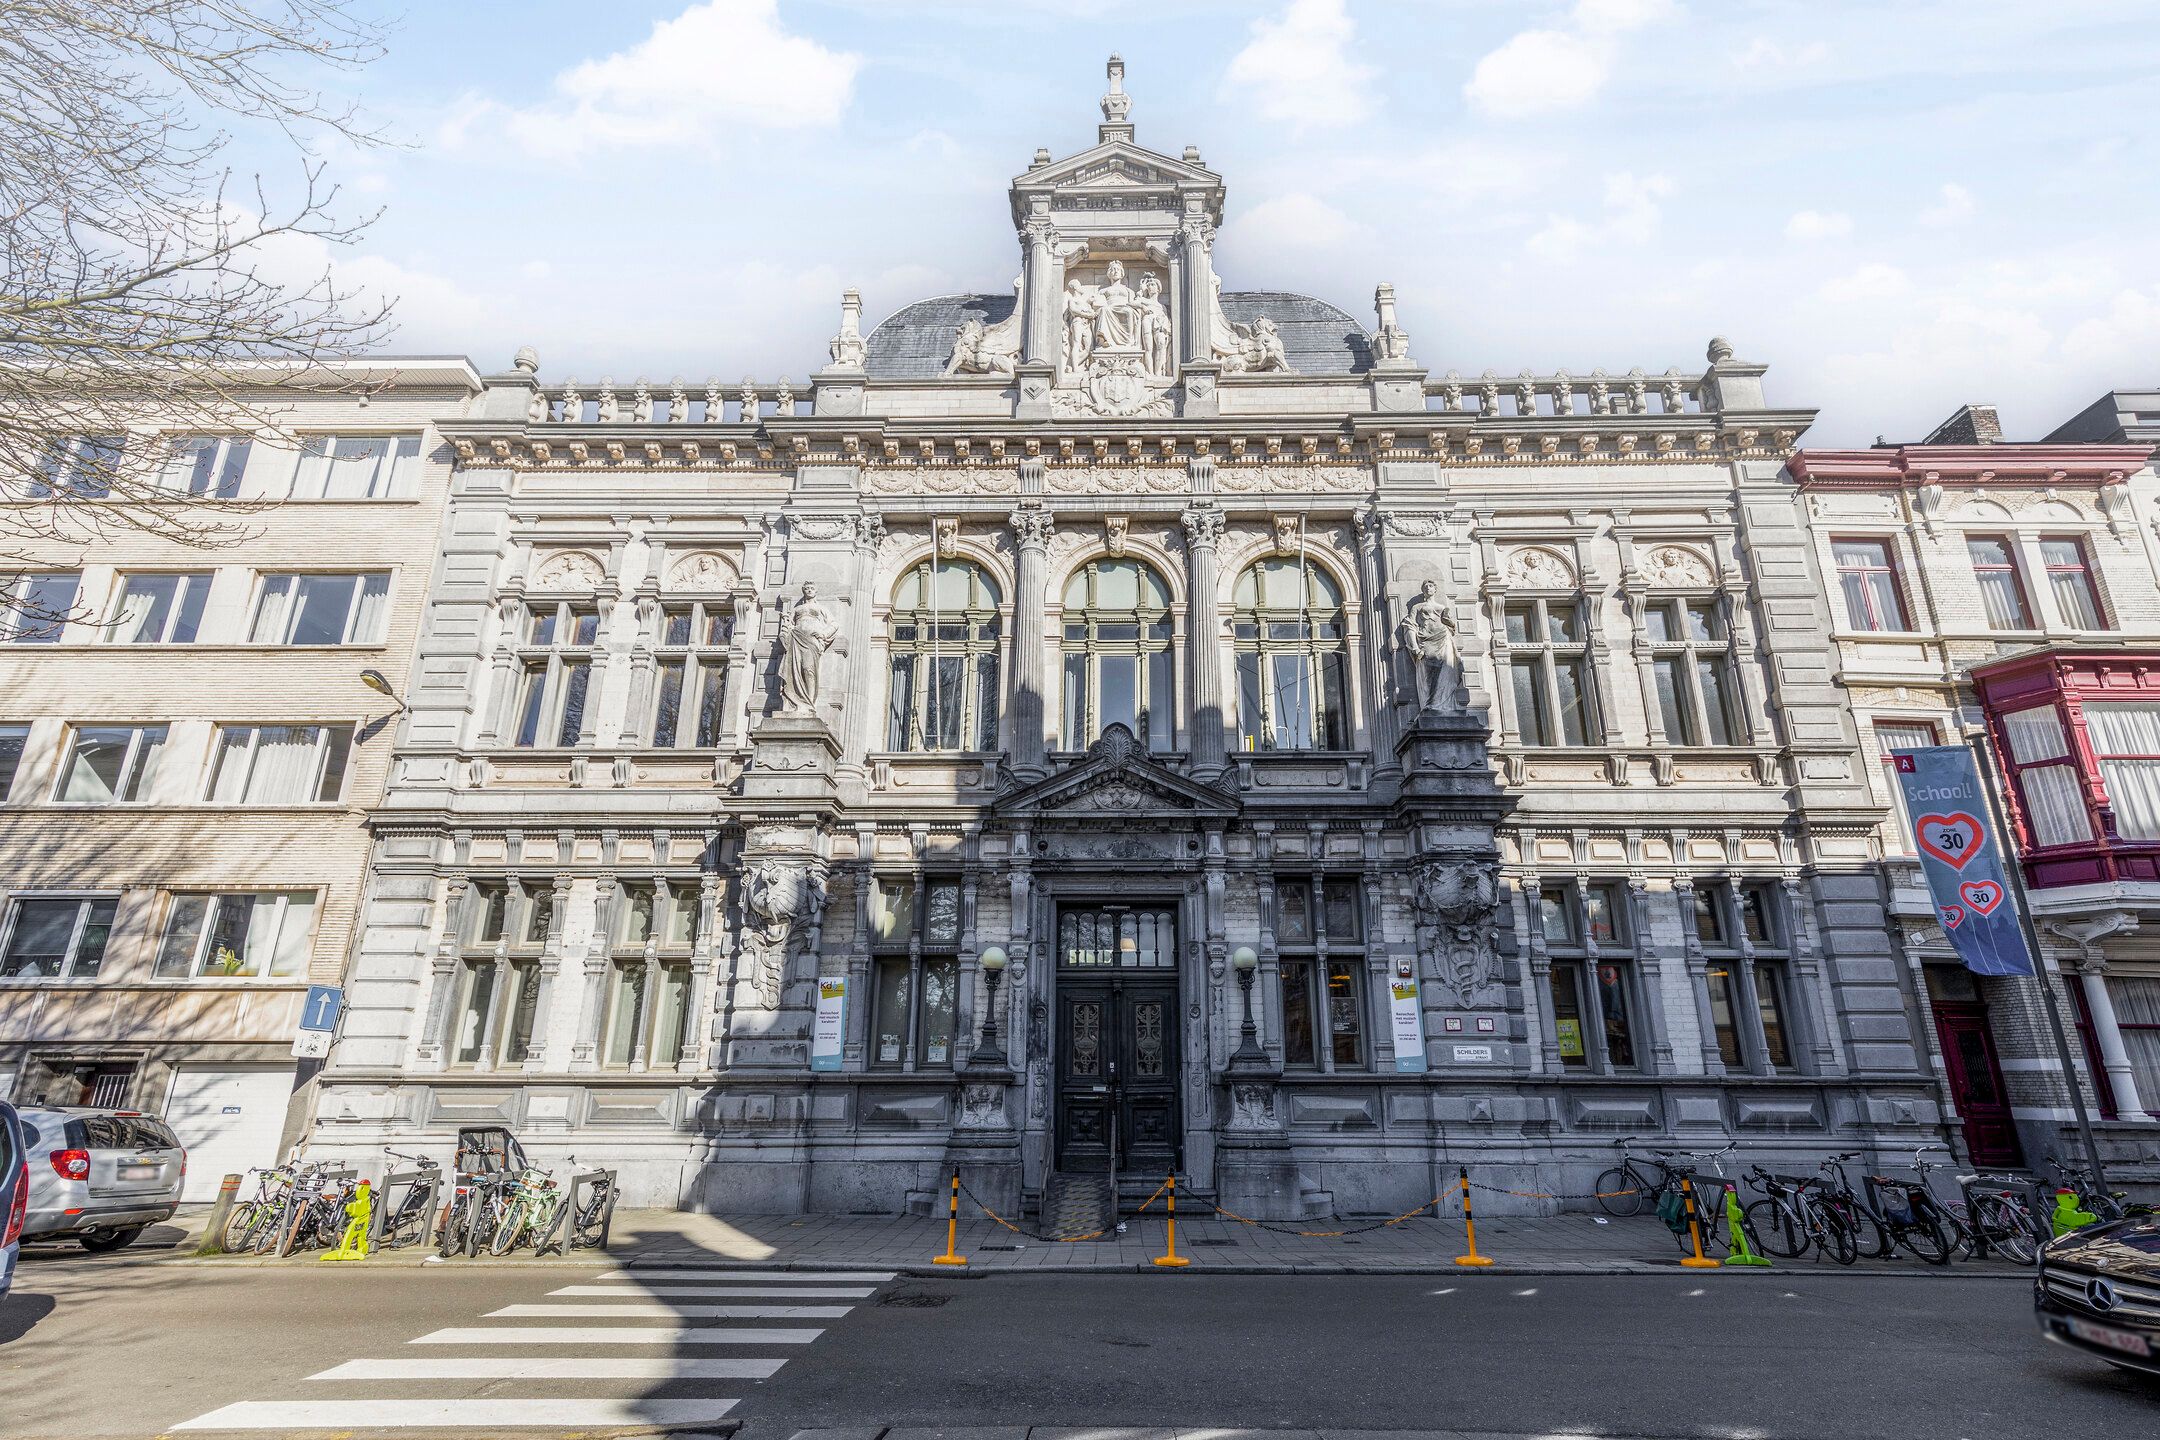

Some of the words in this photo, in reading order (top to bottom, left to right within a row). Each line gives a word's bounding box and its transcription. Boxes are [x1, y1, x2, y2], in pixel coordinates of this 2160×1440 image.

[1902, 759, 1911, 769] A
[1908, 783, 1973, 802] School!
[1939, 833, 1964, 850] 30
[1973, 893, 1989, 904] 30
[1944, 913, 1956, 921] 30
